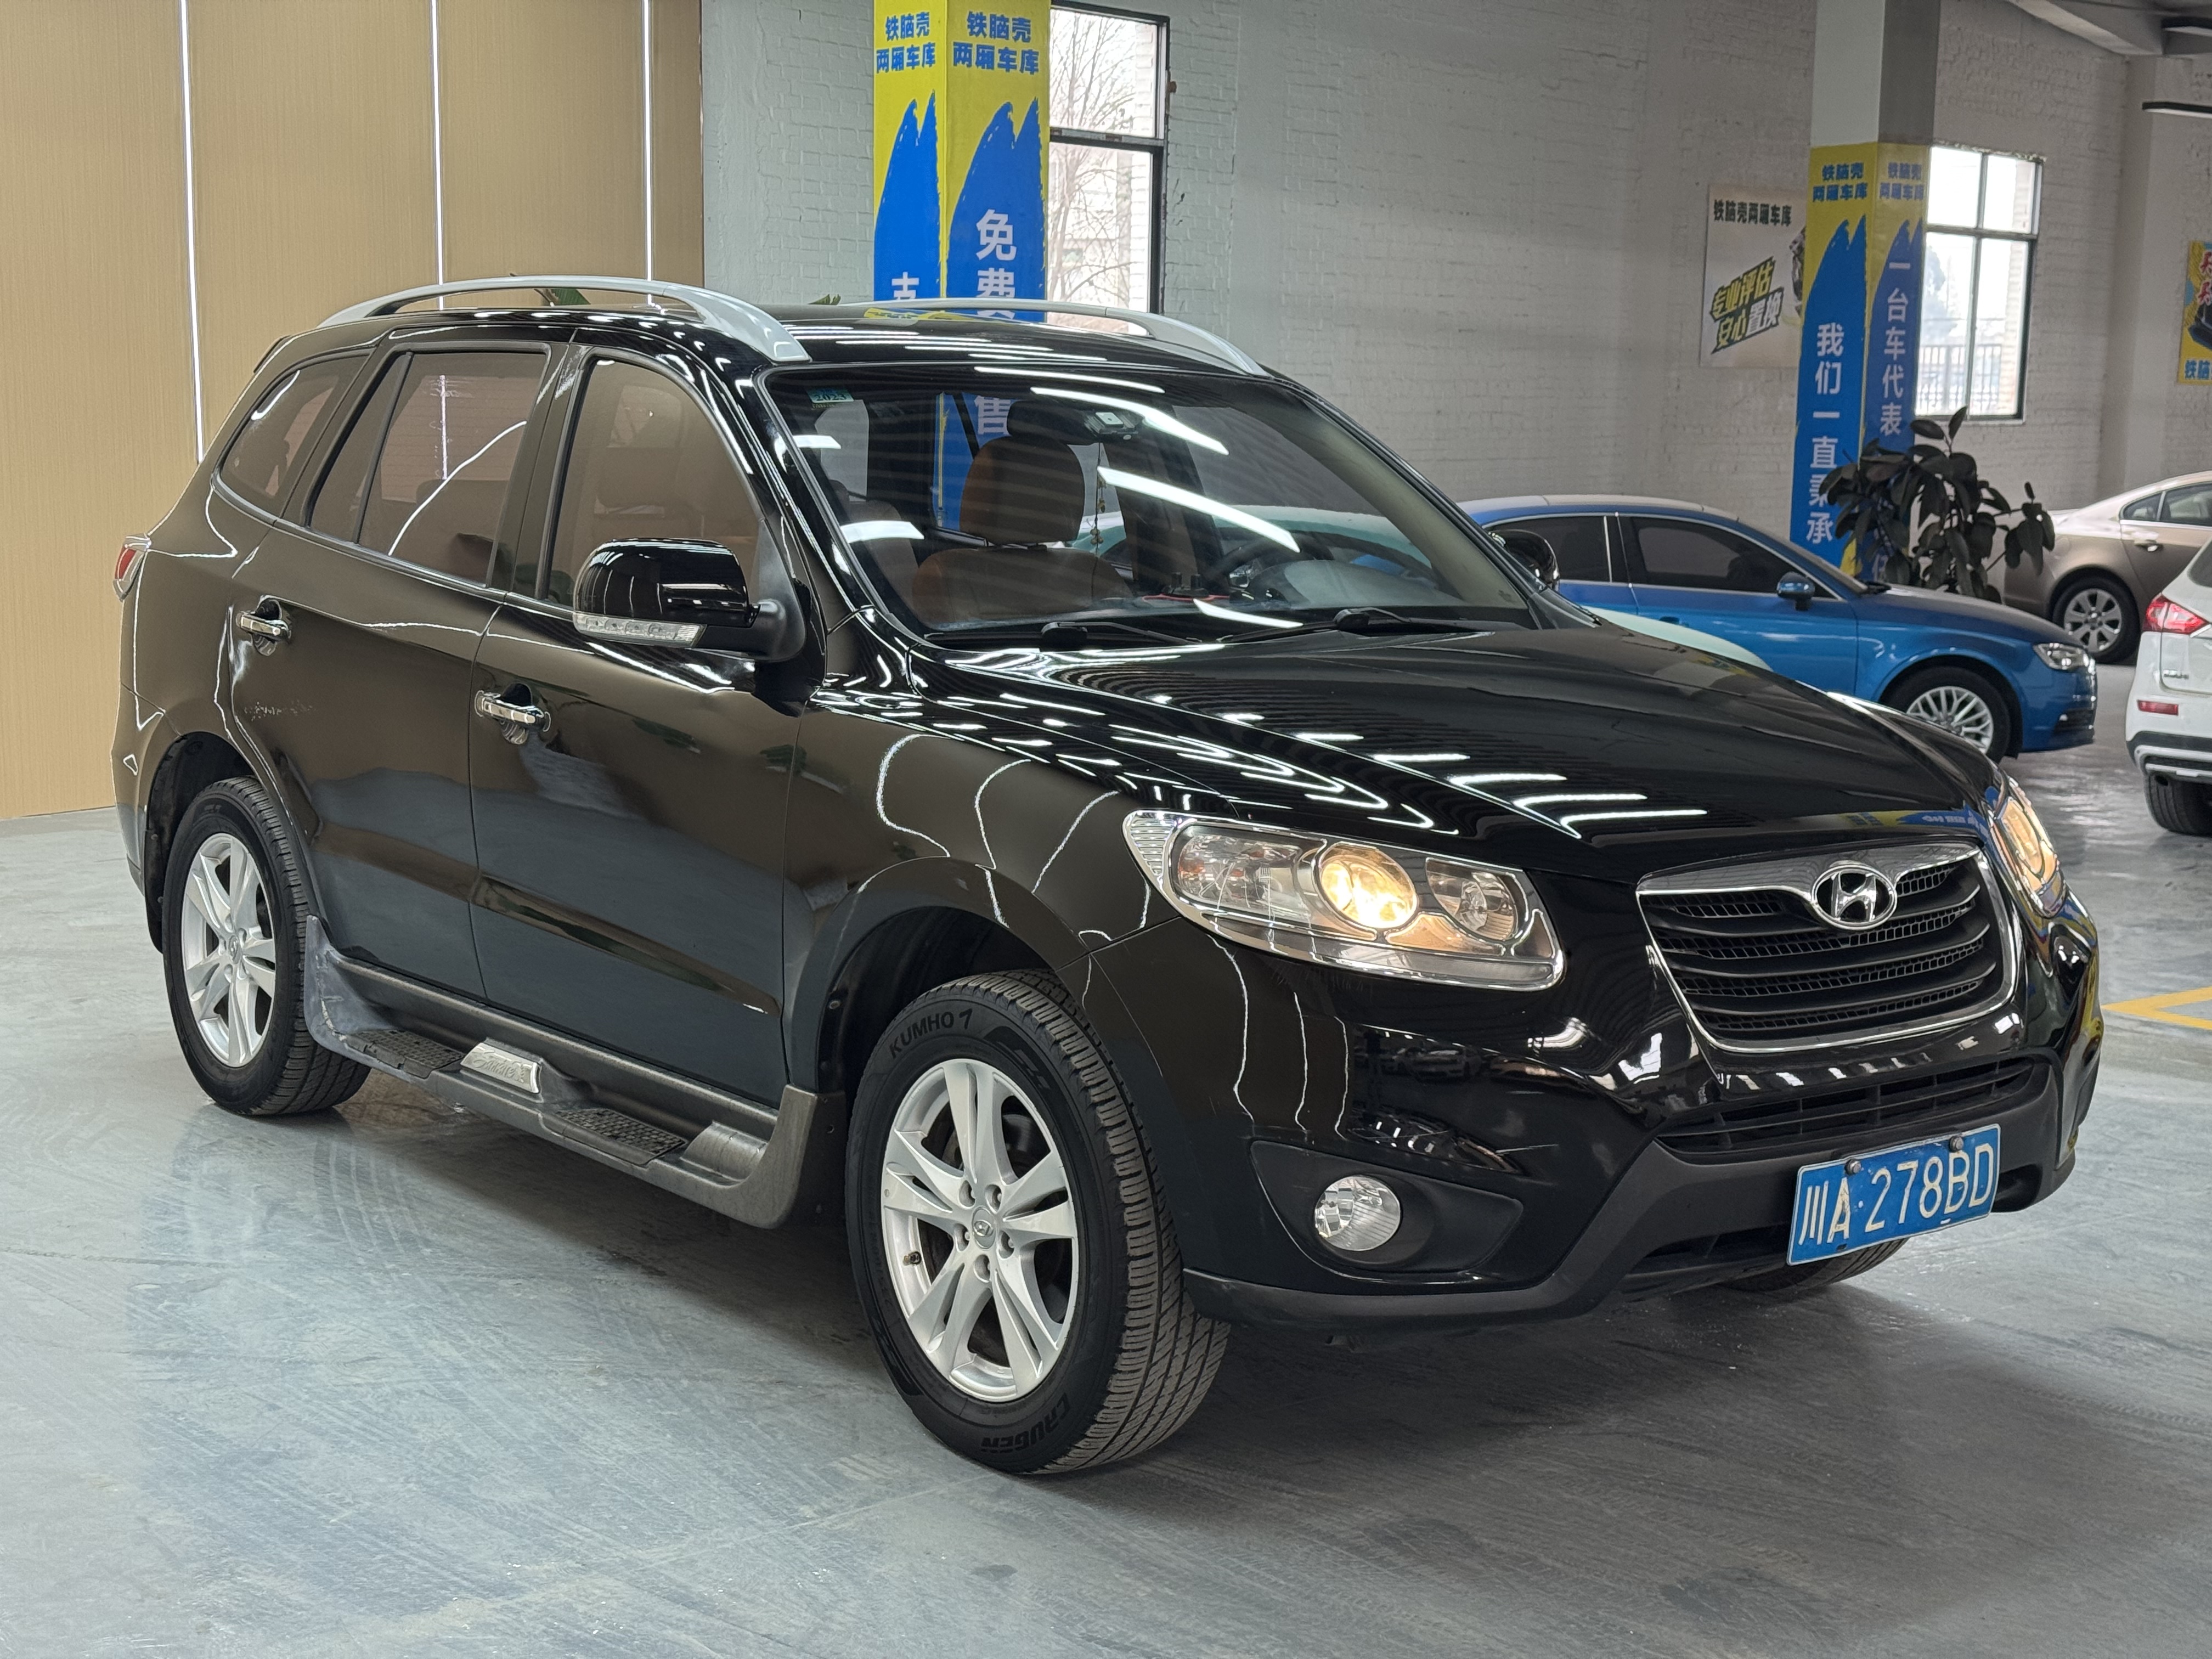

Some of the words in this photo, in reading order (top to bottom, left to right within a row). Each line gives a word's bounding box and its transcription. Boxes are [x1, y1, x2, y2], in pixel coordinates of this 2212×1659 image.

[885, 12, 930, 41] 铁脑壳
[967, 11, 1031, 43] 铁脑壳
[876, 42, 936, 74] 两厢车库
[953, 42, 1039, 75] 两厢车库
[1711, 257, 1776, 320] 专业评估
[889, 1011, 955, 1059] KUMHO
